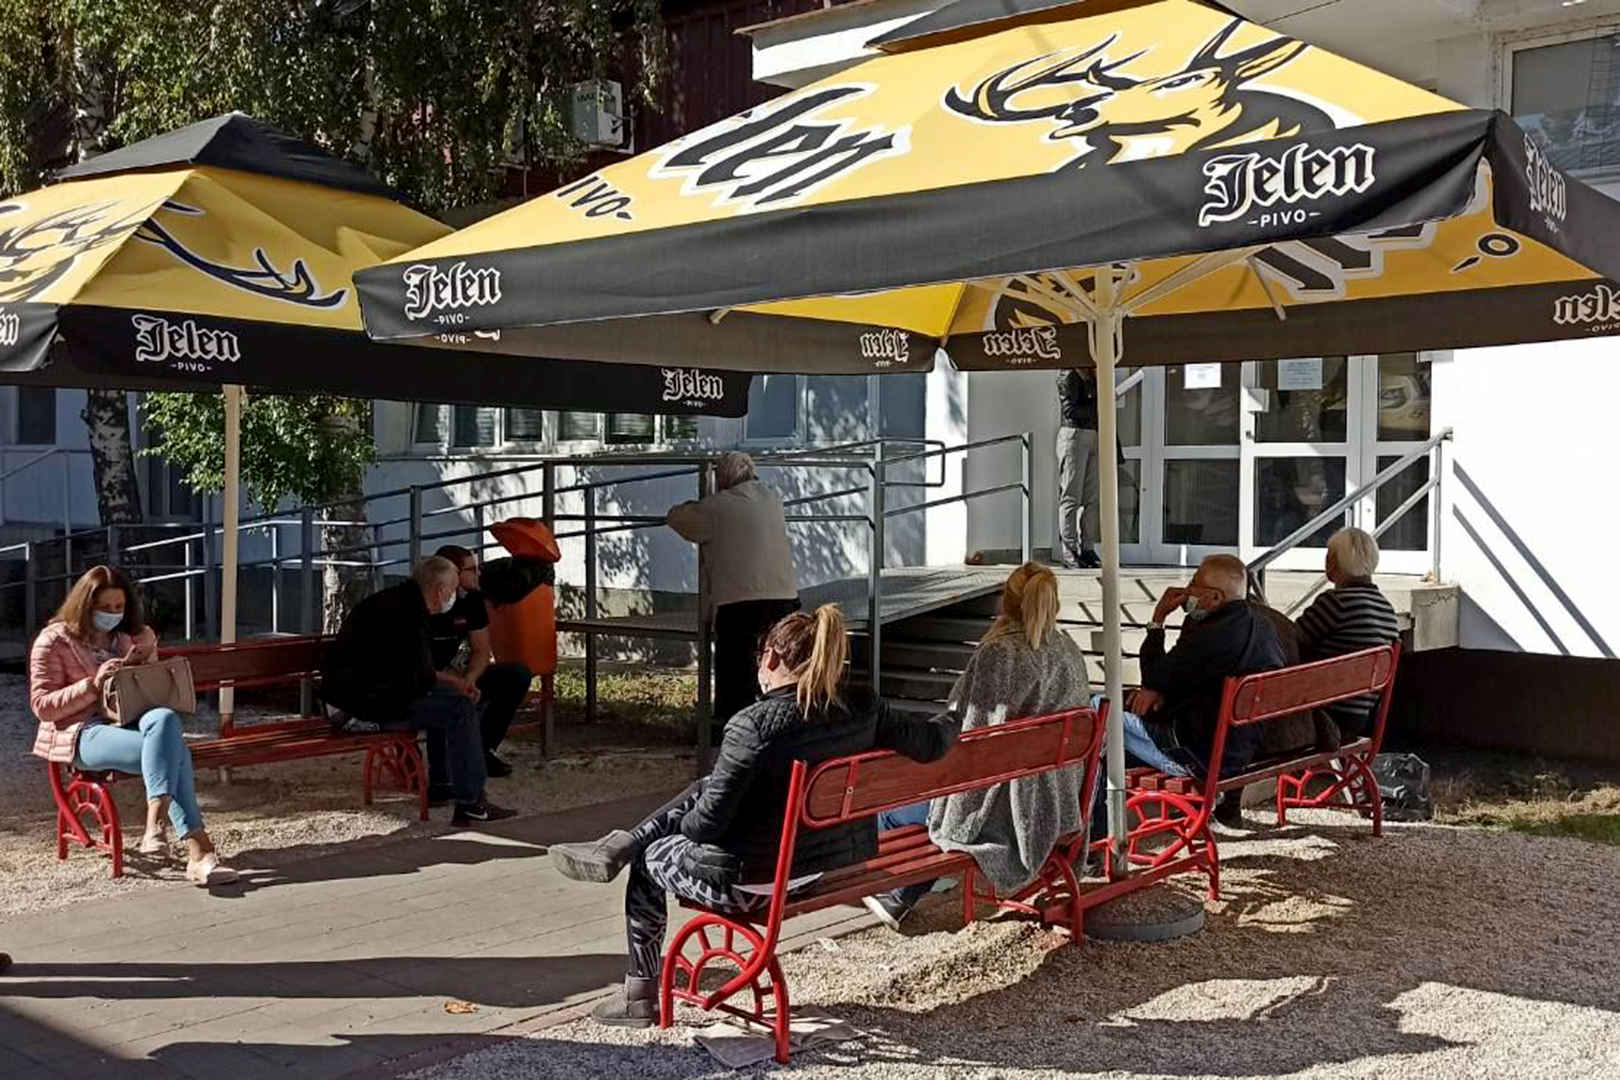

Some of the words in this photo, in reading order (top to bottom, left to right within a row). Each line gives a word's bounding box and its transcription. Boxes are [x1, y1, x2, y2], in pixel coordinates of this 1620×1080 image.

[1198, 143, 1376, 227] Jelen
[403, 261, 502, 320] Jelen
[132, 314, 242, 362] Jelen
[661, 367, 724, 401] Jelen
